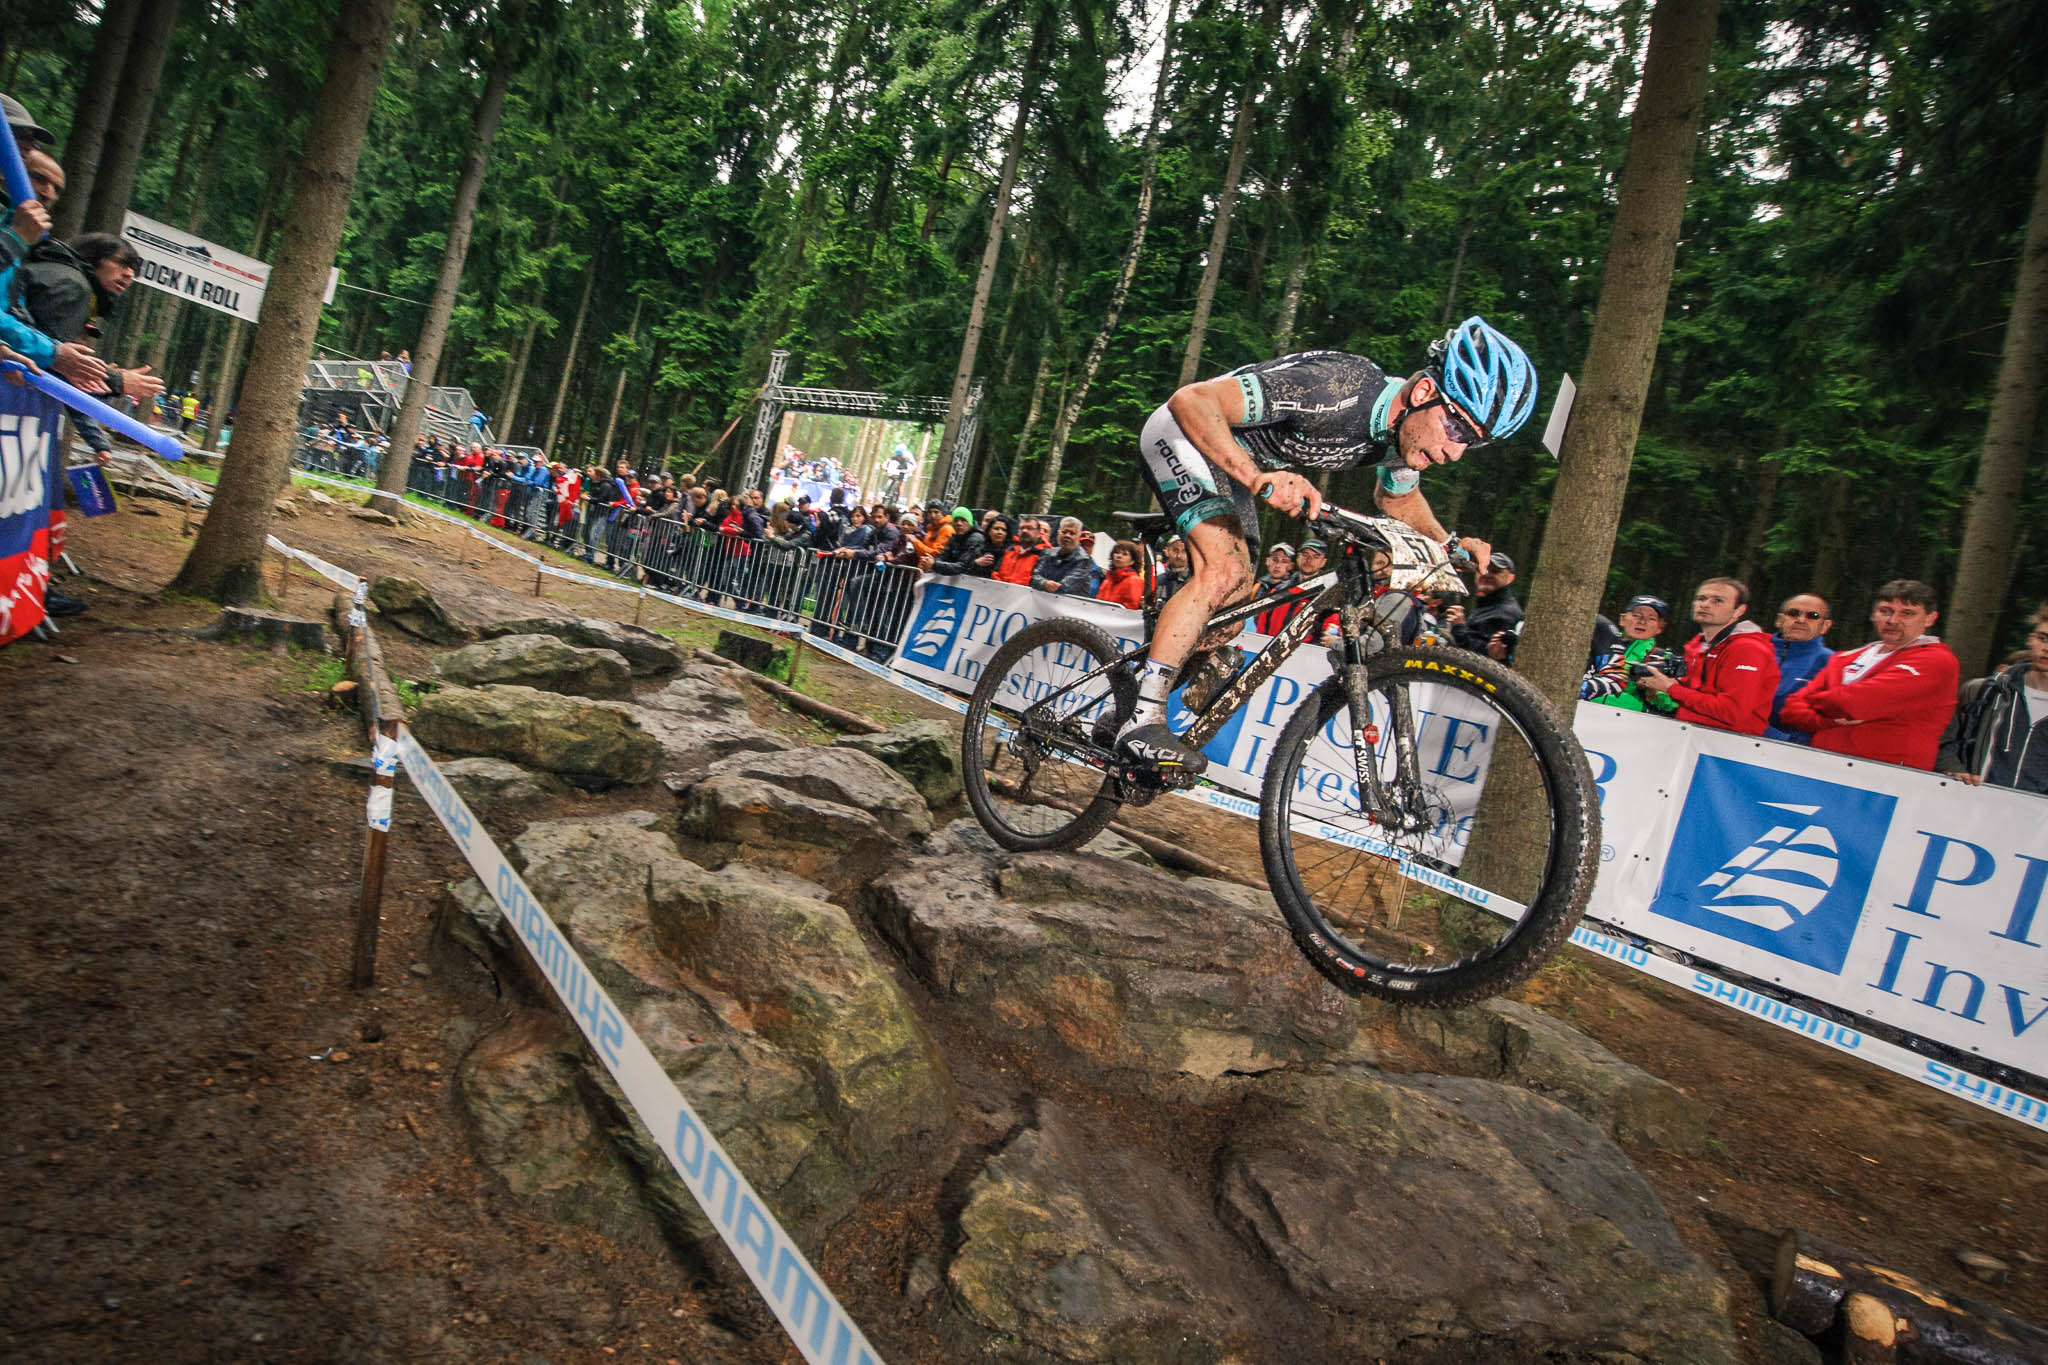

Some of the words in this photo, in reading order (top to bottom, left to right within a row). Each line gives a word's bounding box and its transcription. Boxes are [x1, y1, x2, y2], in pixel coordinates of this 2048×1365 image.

[137, 257, 182, 291] OCK
[184, 275, 198, 296] N
[200, 280, 240, 311] ROLL
[1154, 438, 1192, 487] FOCUS
[1400, 535, 1437, 566] 57
[1404, 659, 1497, 694] MAXXIS
[1692, 972, 1861, 1050] SHIMANO
